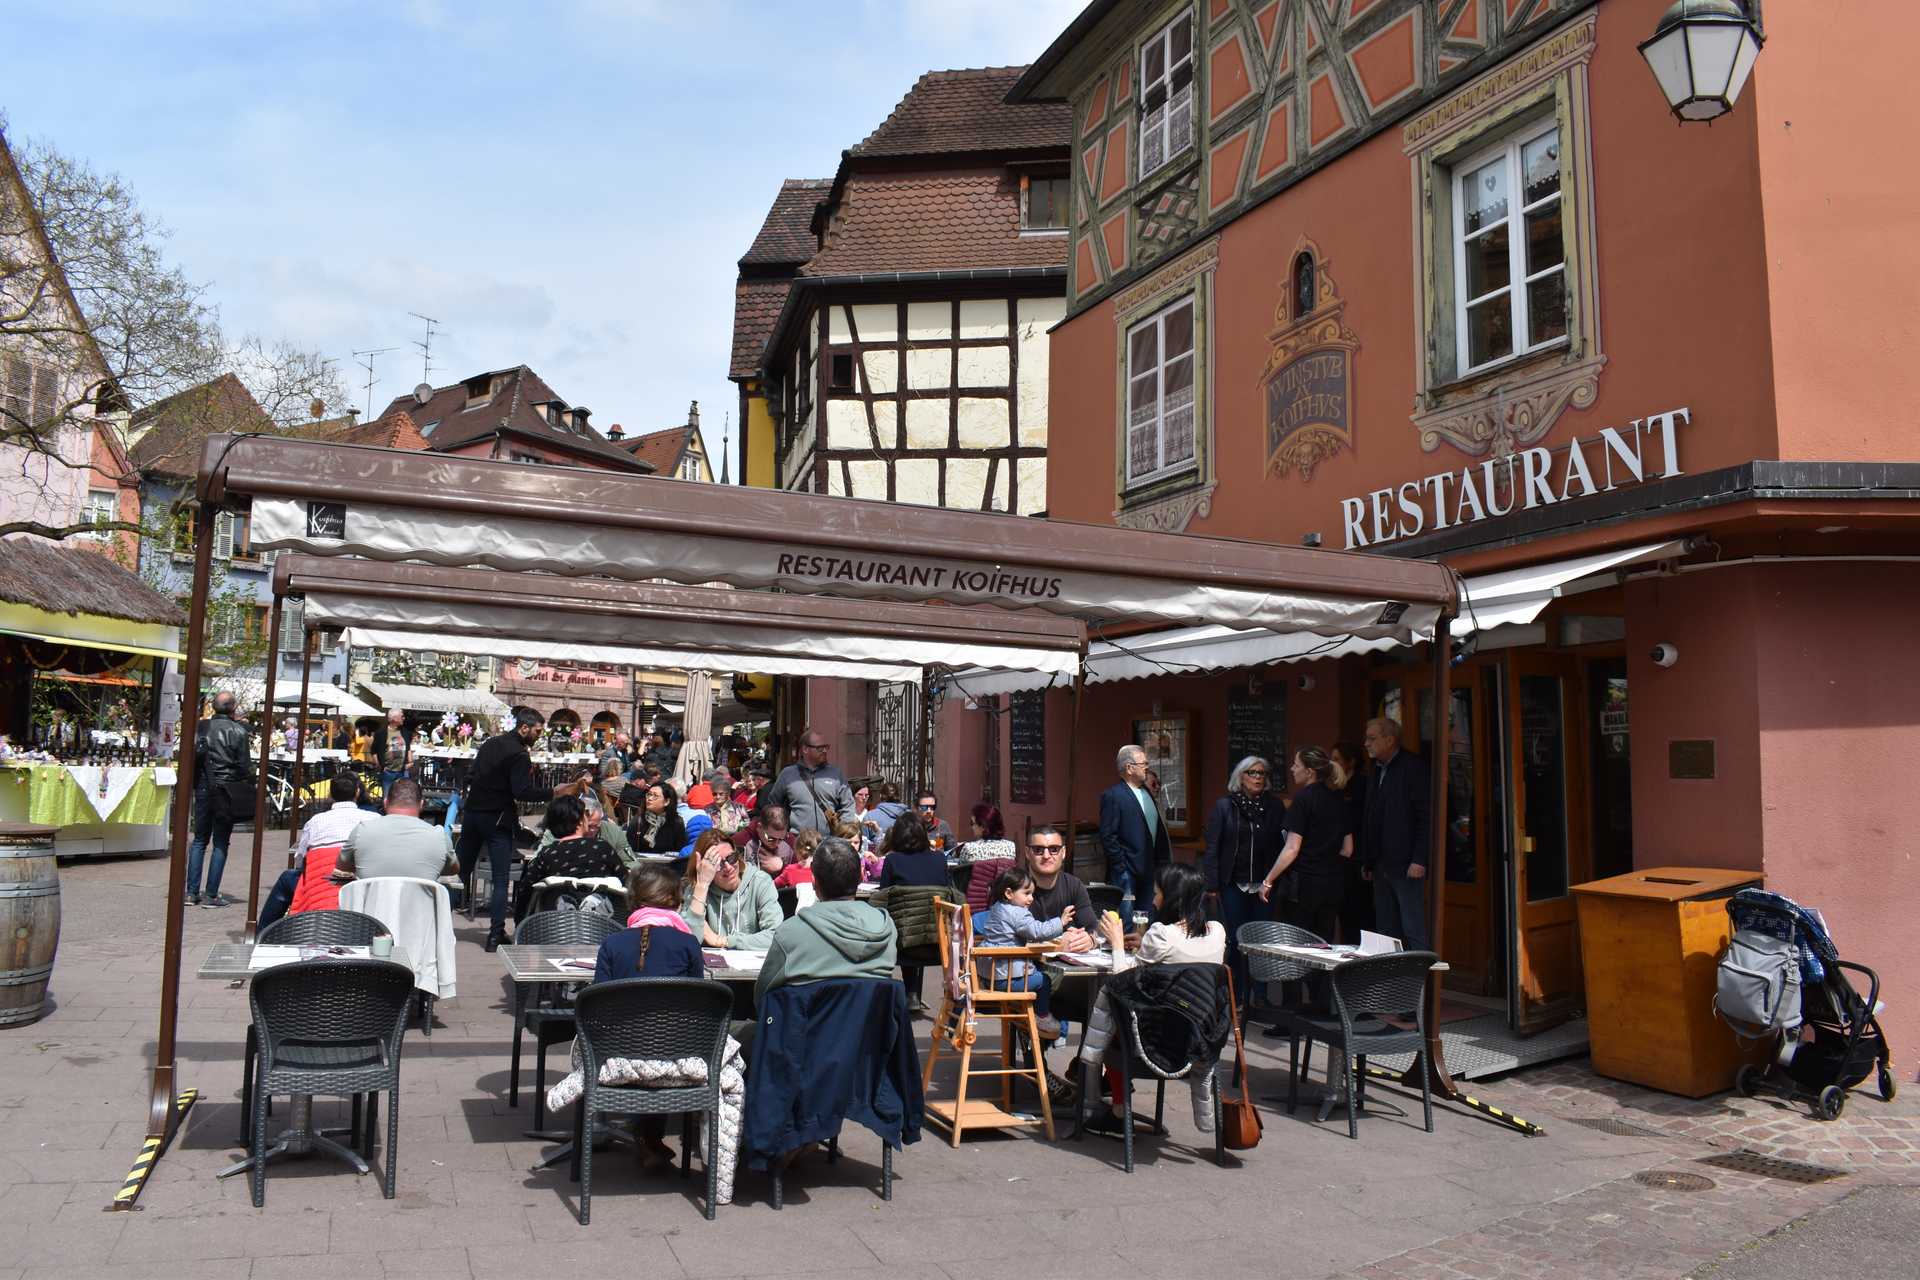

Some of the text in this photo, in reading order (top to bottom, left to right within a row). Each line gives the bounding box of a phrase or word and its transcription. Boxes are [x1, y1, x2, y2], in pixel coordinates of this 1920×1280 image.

[1340, 407, 1690, 550] RESTAURANT
[777, 553, 947, 587] RESTAURANT
[567, 673, 595, 685] Martin
